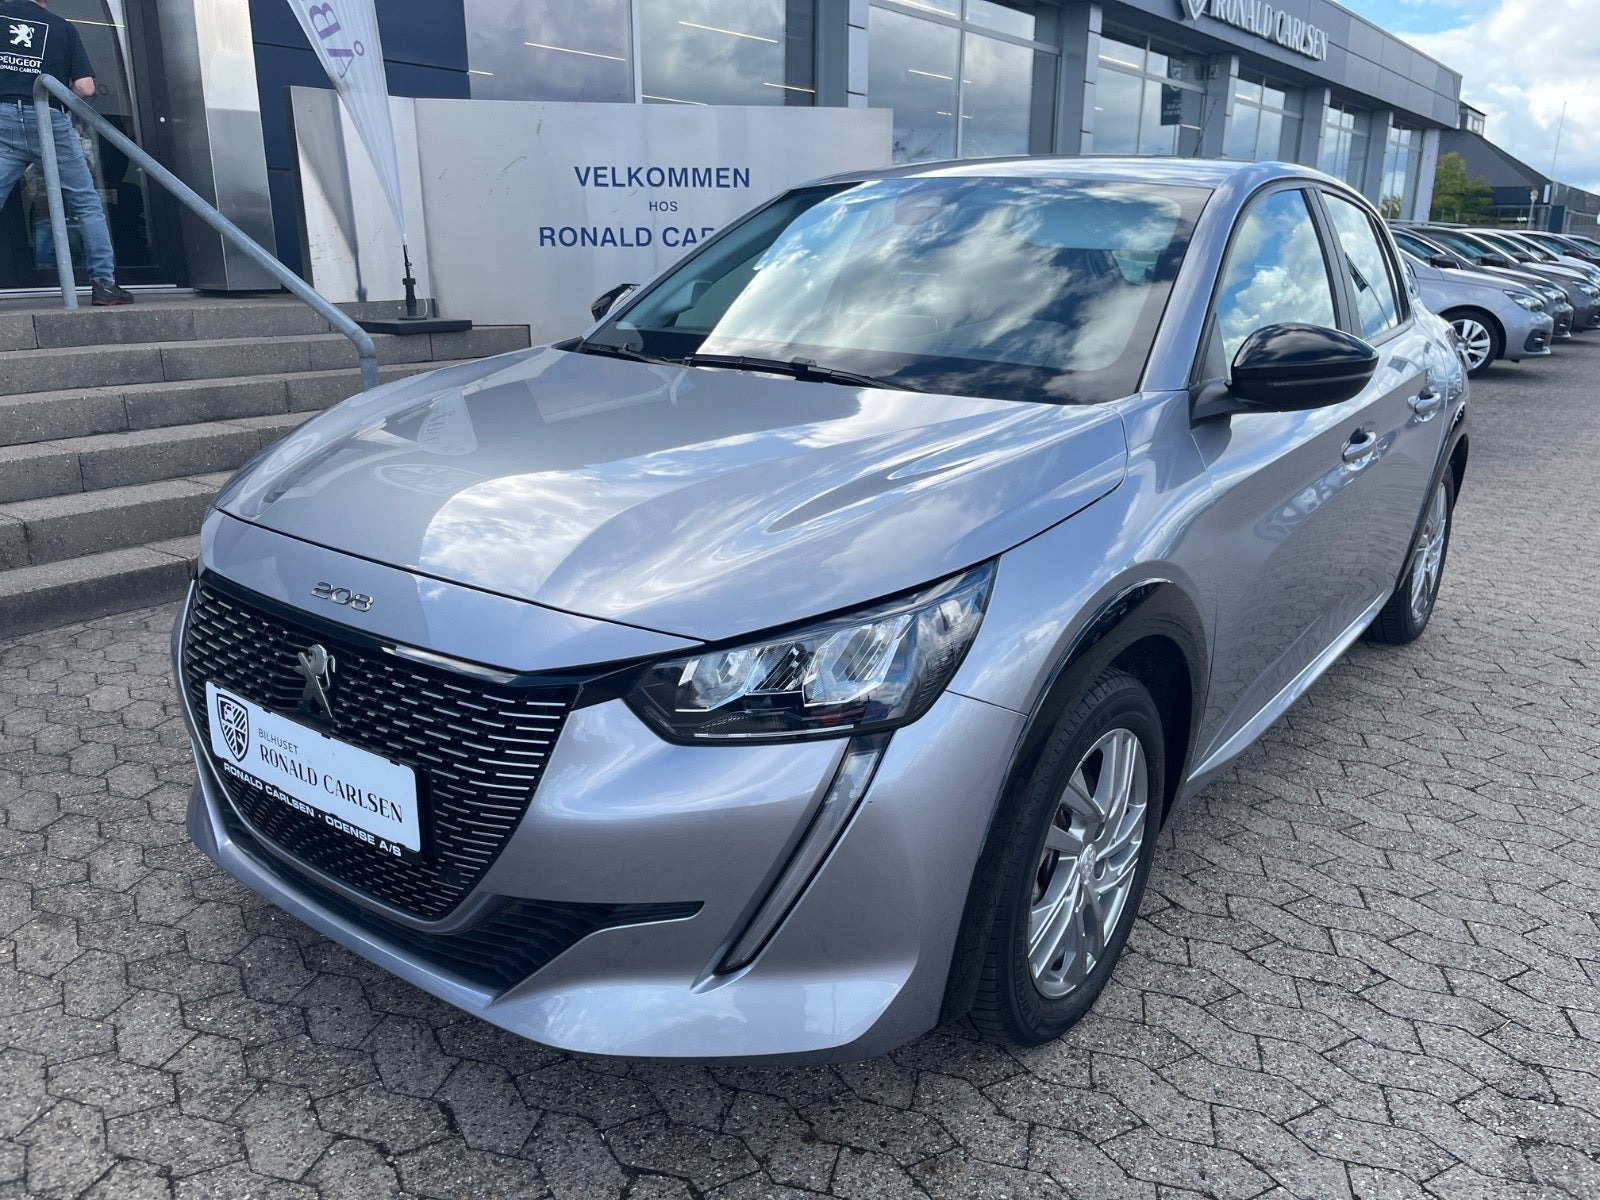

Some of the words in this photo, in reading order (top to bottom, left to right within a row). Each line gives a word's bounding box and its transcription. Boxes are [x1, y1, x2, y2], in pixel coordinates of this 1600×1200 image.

[303, 0, 365, 78] ÅB
[1275, 10, 1329, 62] CARLSEN
[574, 166, 750, 188] VELKOMMEN
[649, 201, 678, 212] HOS
[539, 226, 653, 247] RONALD
[310, 581, 374, 612] 208
[258, 727, 298, 755] BILHUSET
[259, 743, 318, 786] RONALD
[323, 774, 403, 824] CARLSEN
[223, 761, 263, 791] RONALD
[265, 785, 315, 818] CARLSEN
[324, 814, 376, 846] ODENSE
[379, 840, 402, 857] A/S
